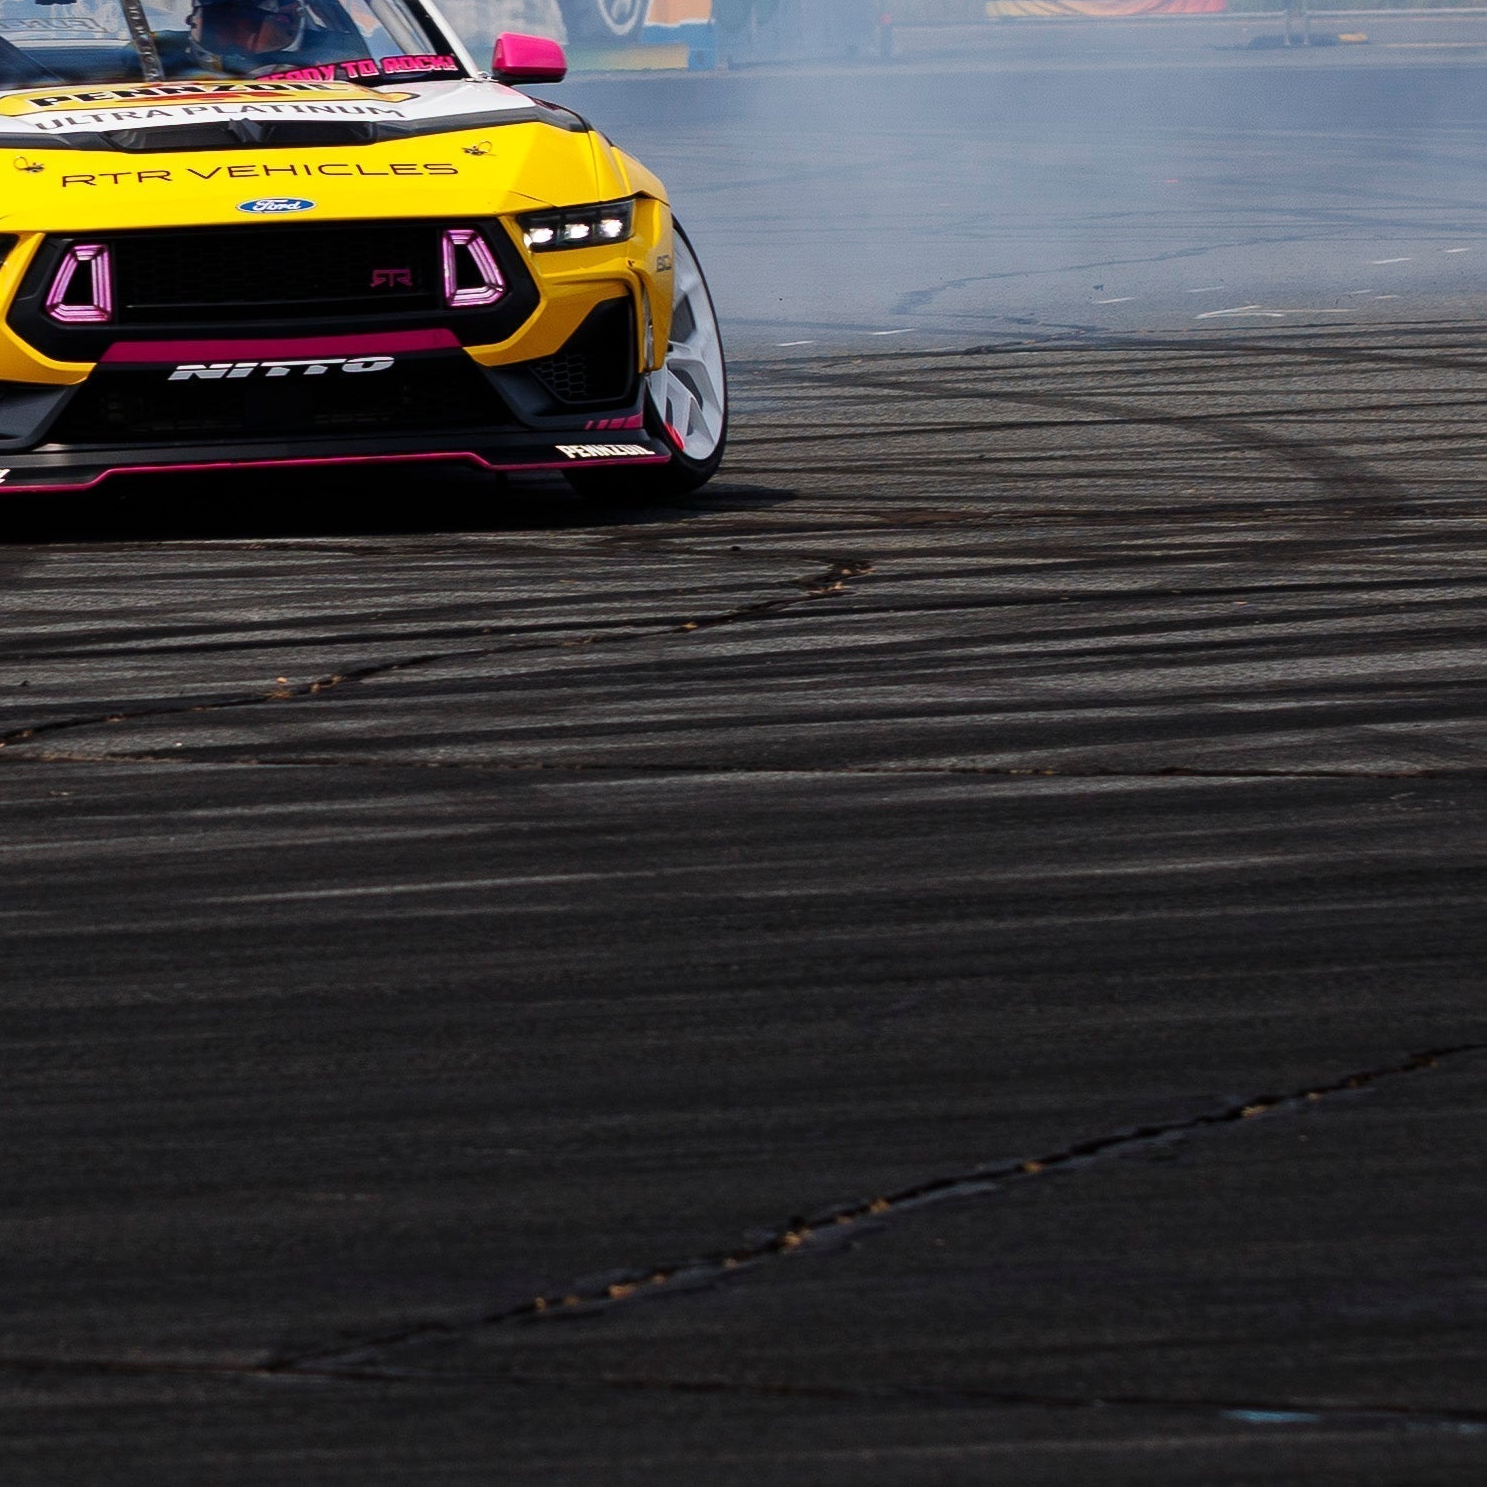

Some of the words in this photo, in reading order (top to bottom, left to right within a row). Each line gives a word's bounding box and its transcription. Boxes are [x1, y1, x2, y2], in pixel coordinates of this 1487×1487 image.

[341, 60, 380, 78] TO
[381, 54, 458, 75] ROCK!
[36, 109, 173, 131] ULTRA
[182, 103, 406, 120] PLATINUM
[62, 170, 172, 187] RTR
[187, 163, 459, 180] VEHICLES
[168, 356, 395, 381] NITTO
